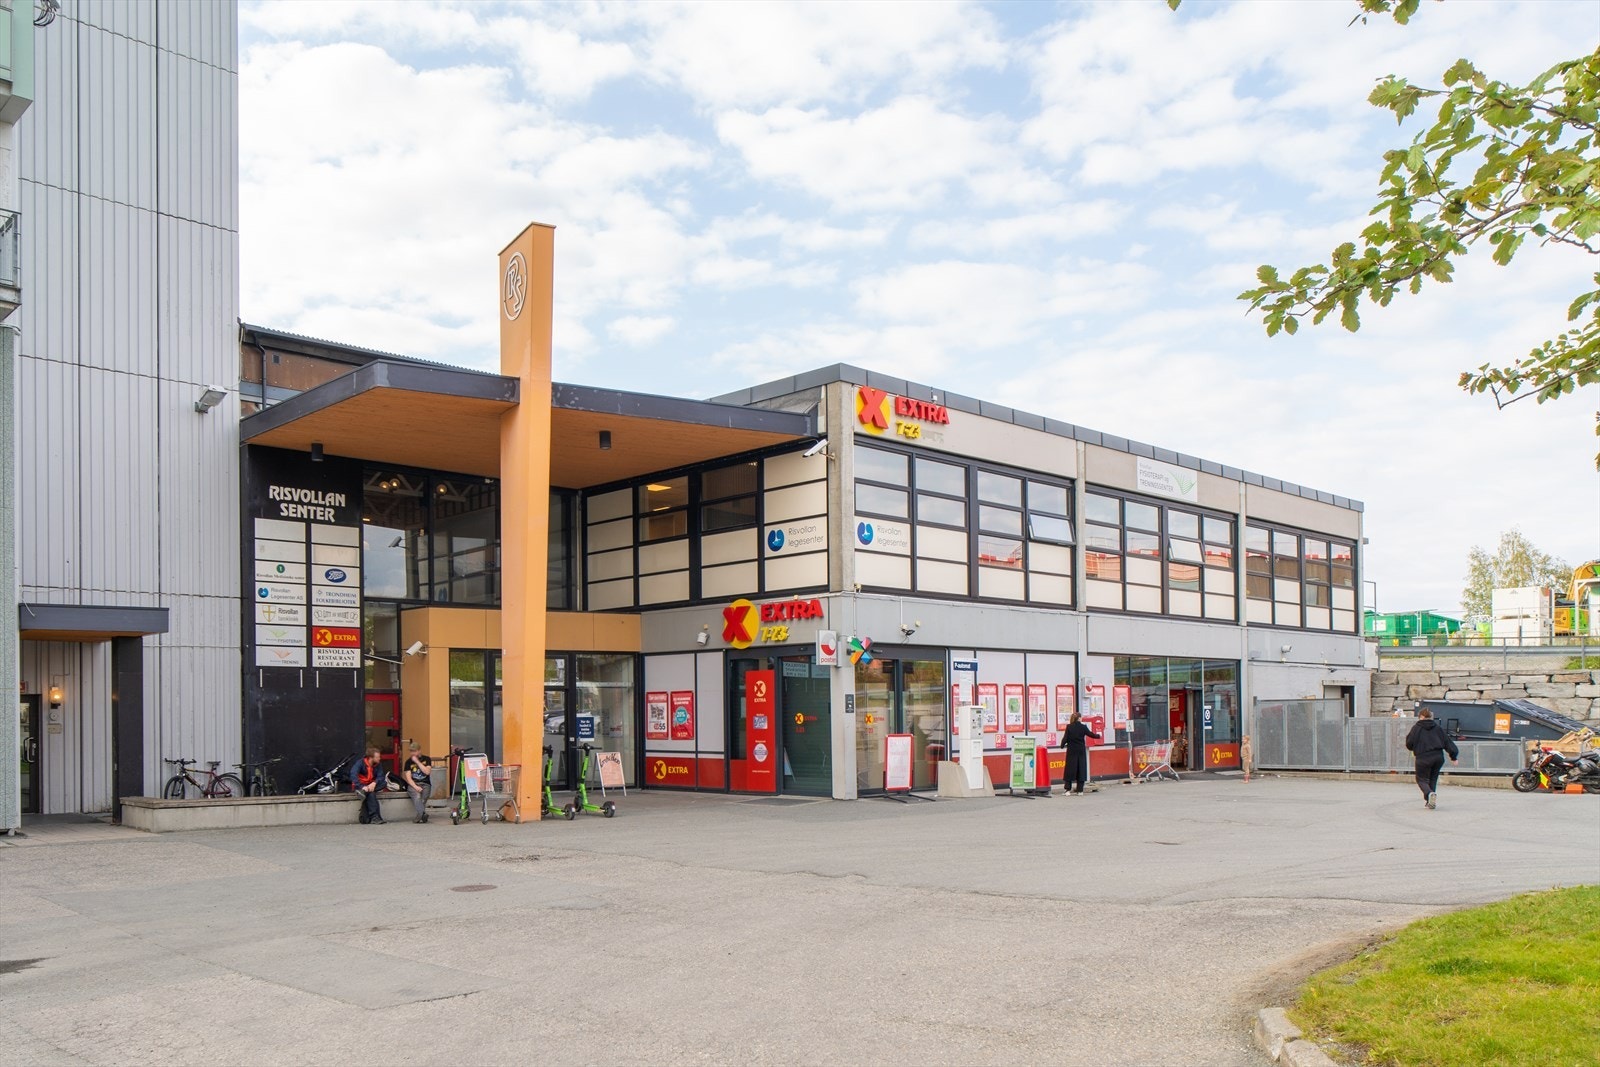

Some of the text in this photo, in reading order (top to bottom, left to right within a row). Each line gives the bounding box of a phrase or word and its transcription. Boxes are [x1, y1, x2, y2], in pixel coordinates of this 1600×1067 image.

[895, 395, 950, 424] EXTRA
[269, 485, 346, 507] RISVOLLAN
[280, 502, 336, 522] SENTER
[788, 524, 817, 536] Risvollan
[876, 525, 902, 536] Risvollan
[788, 535, 824, 548] legesenter
[876, 536, 908, 548] legesenter
[760, 598, 823, 623] EXTRA
[1220, 751, 1233, 759] EXTRA
[668, 766, 688, 774] EXTRA
